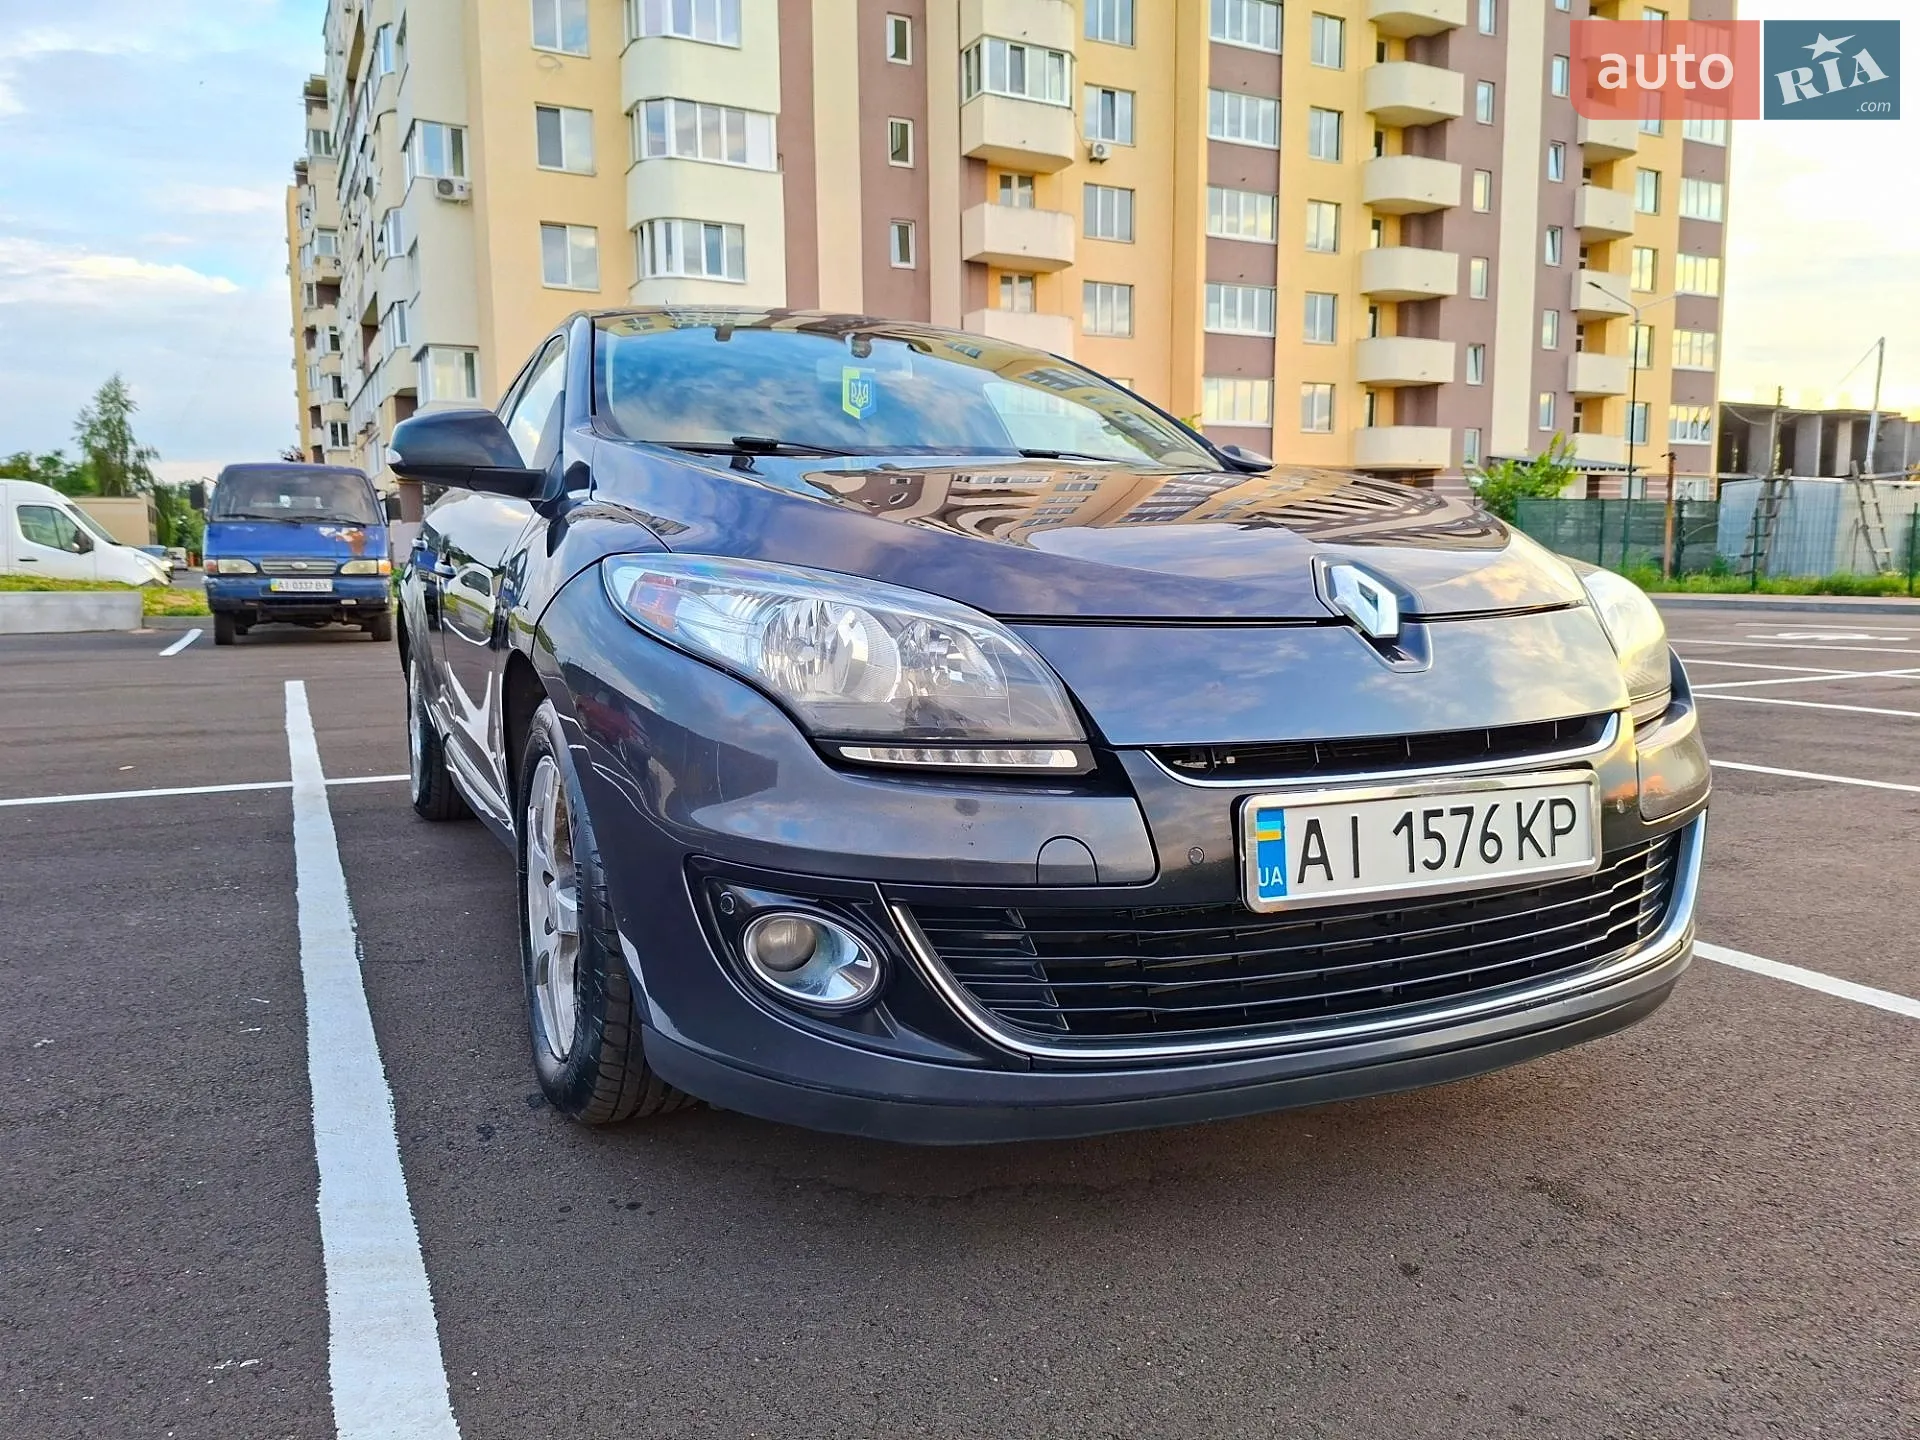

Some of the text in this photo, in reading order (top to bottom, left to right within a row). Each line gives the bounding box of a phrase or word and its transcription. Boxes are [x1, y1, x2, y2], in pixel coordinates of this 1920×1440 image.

[1297, 797, 1577, 884] AI 1576 KP
[1258, 866, 1284, 887] UA
